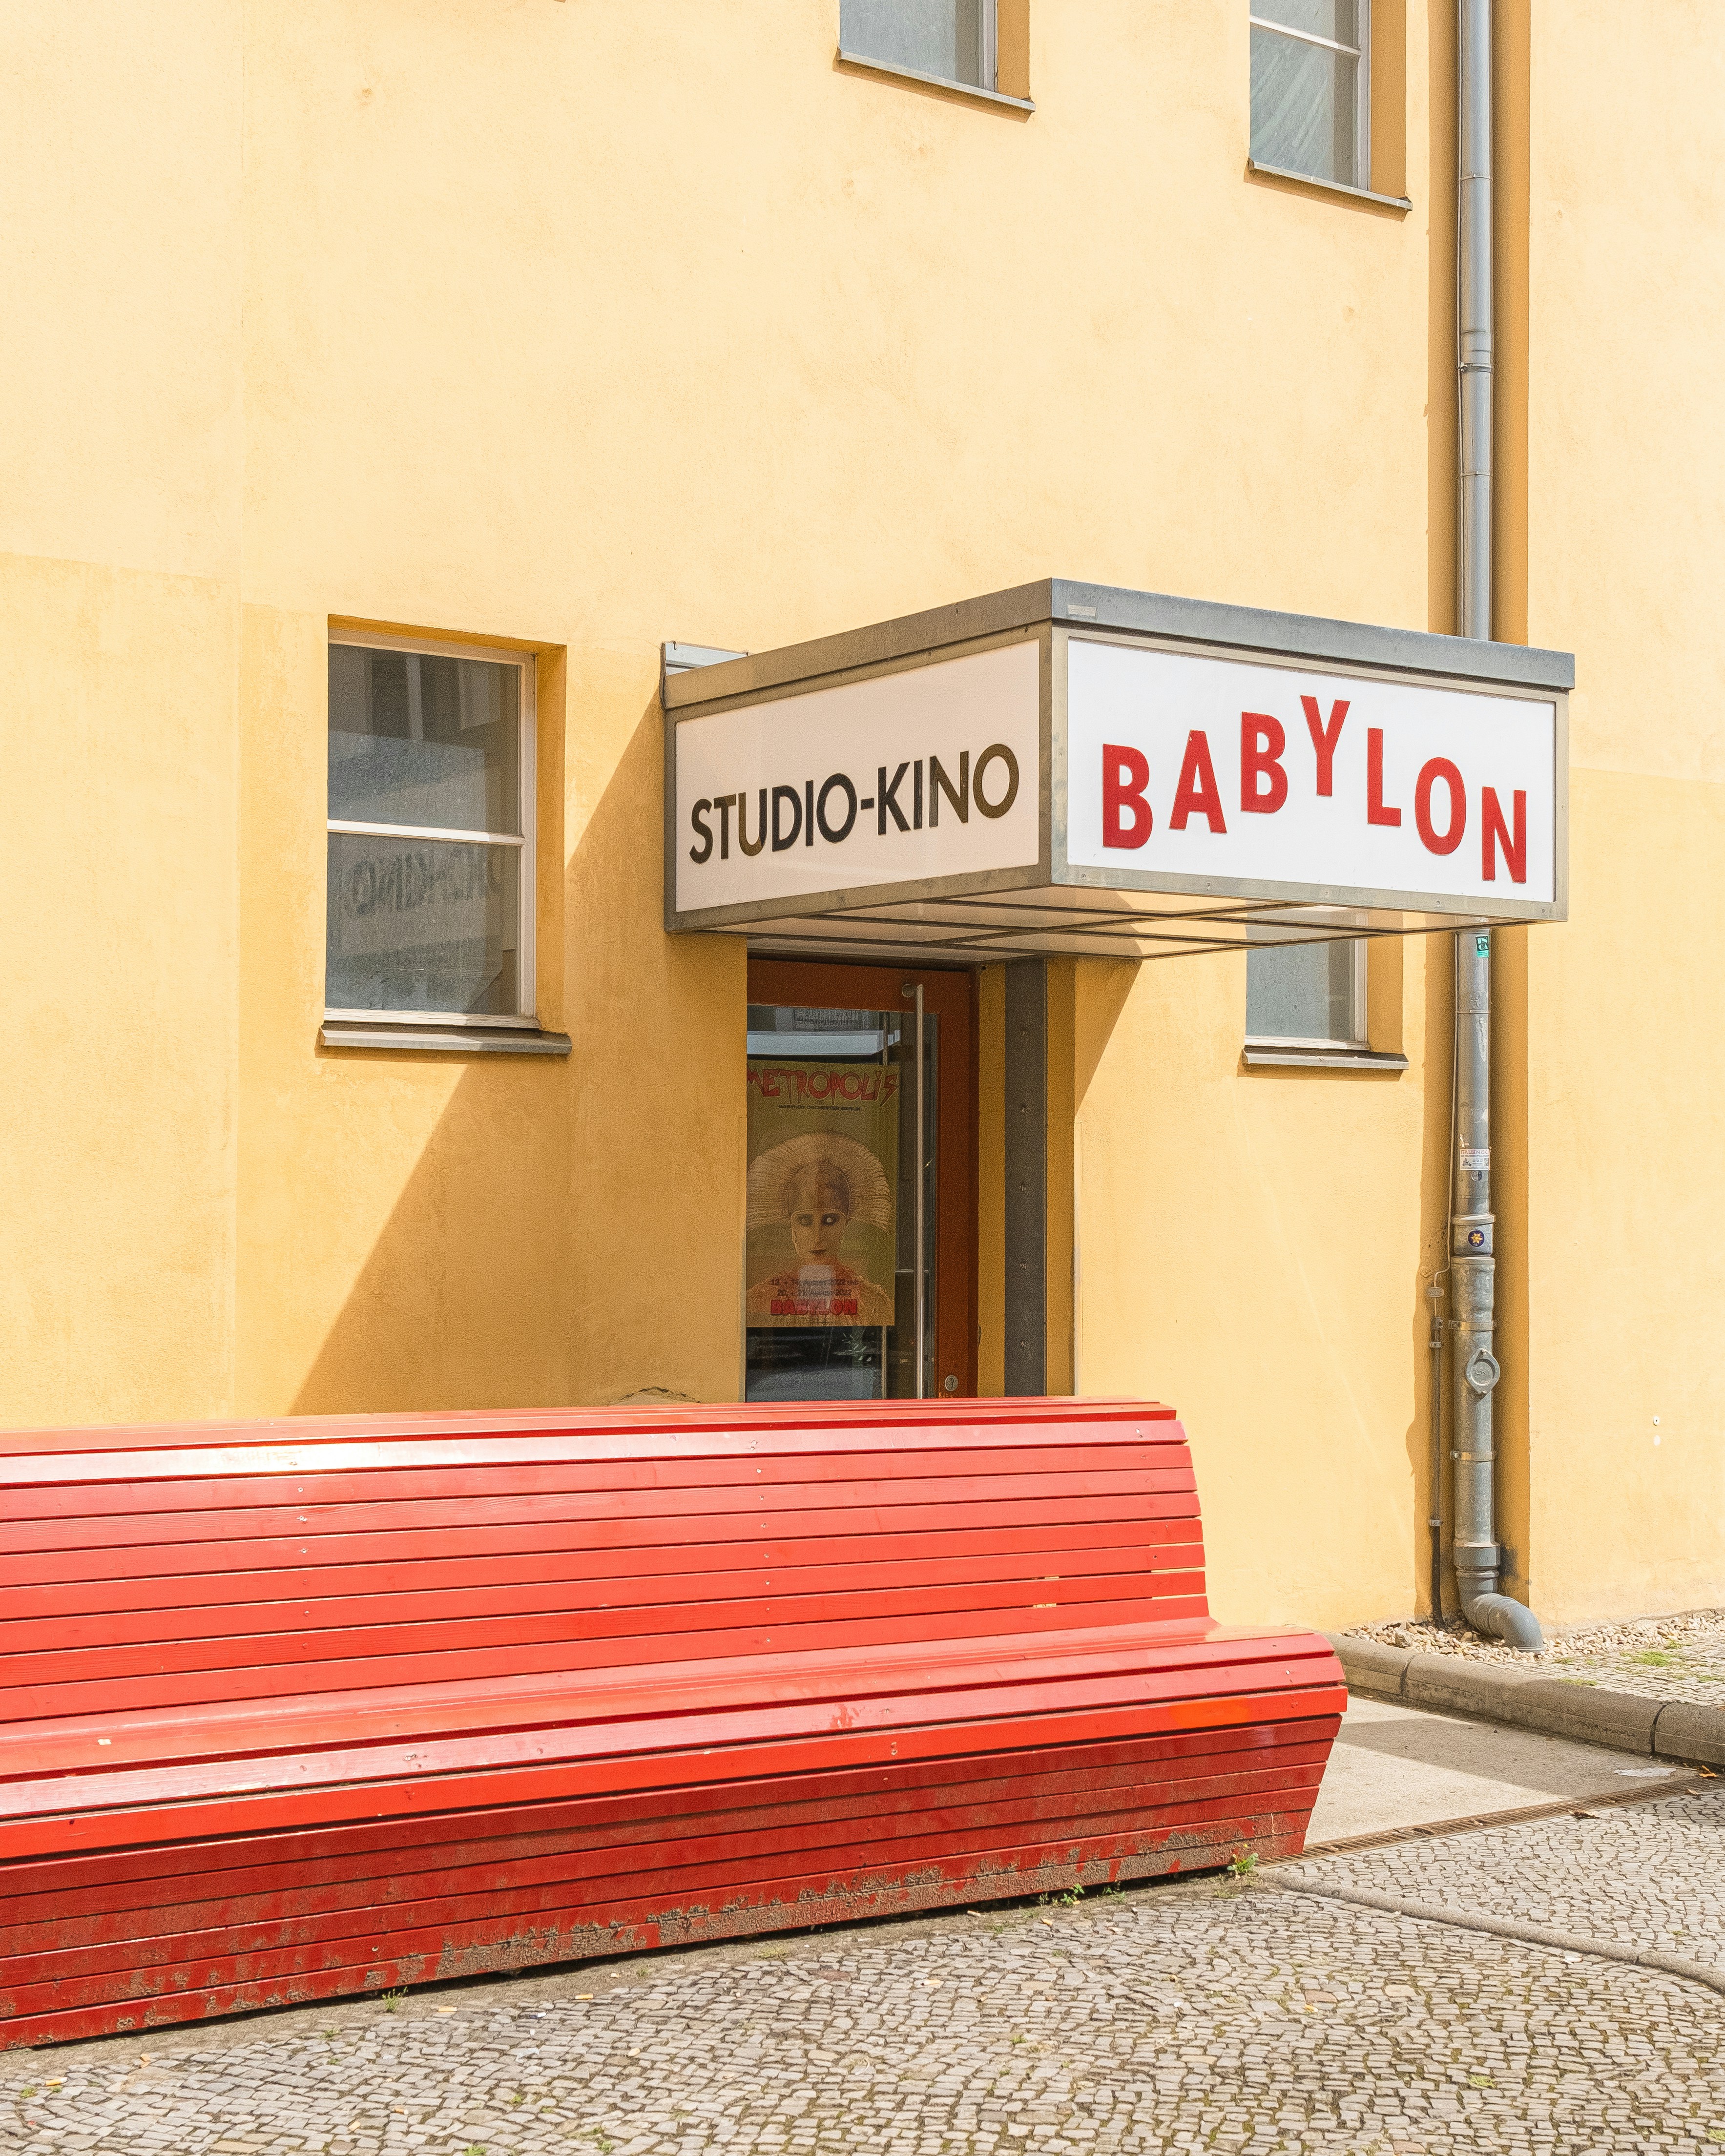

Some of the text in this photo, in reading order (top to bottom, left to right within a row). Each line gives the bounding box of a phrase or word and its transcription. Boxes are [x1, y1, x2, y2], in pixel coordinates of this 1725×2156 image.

[689, 743, 1019, 864] STUDIO-KINO
[1102, 694, 1527, 884] BABYLON
[747, 1061, 898, 1107] METROPOLIS
[770, 1299, 858, 1315] BABYLON
